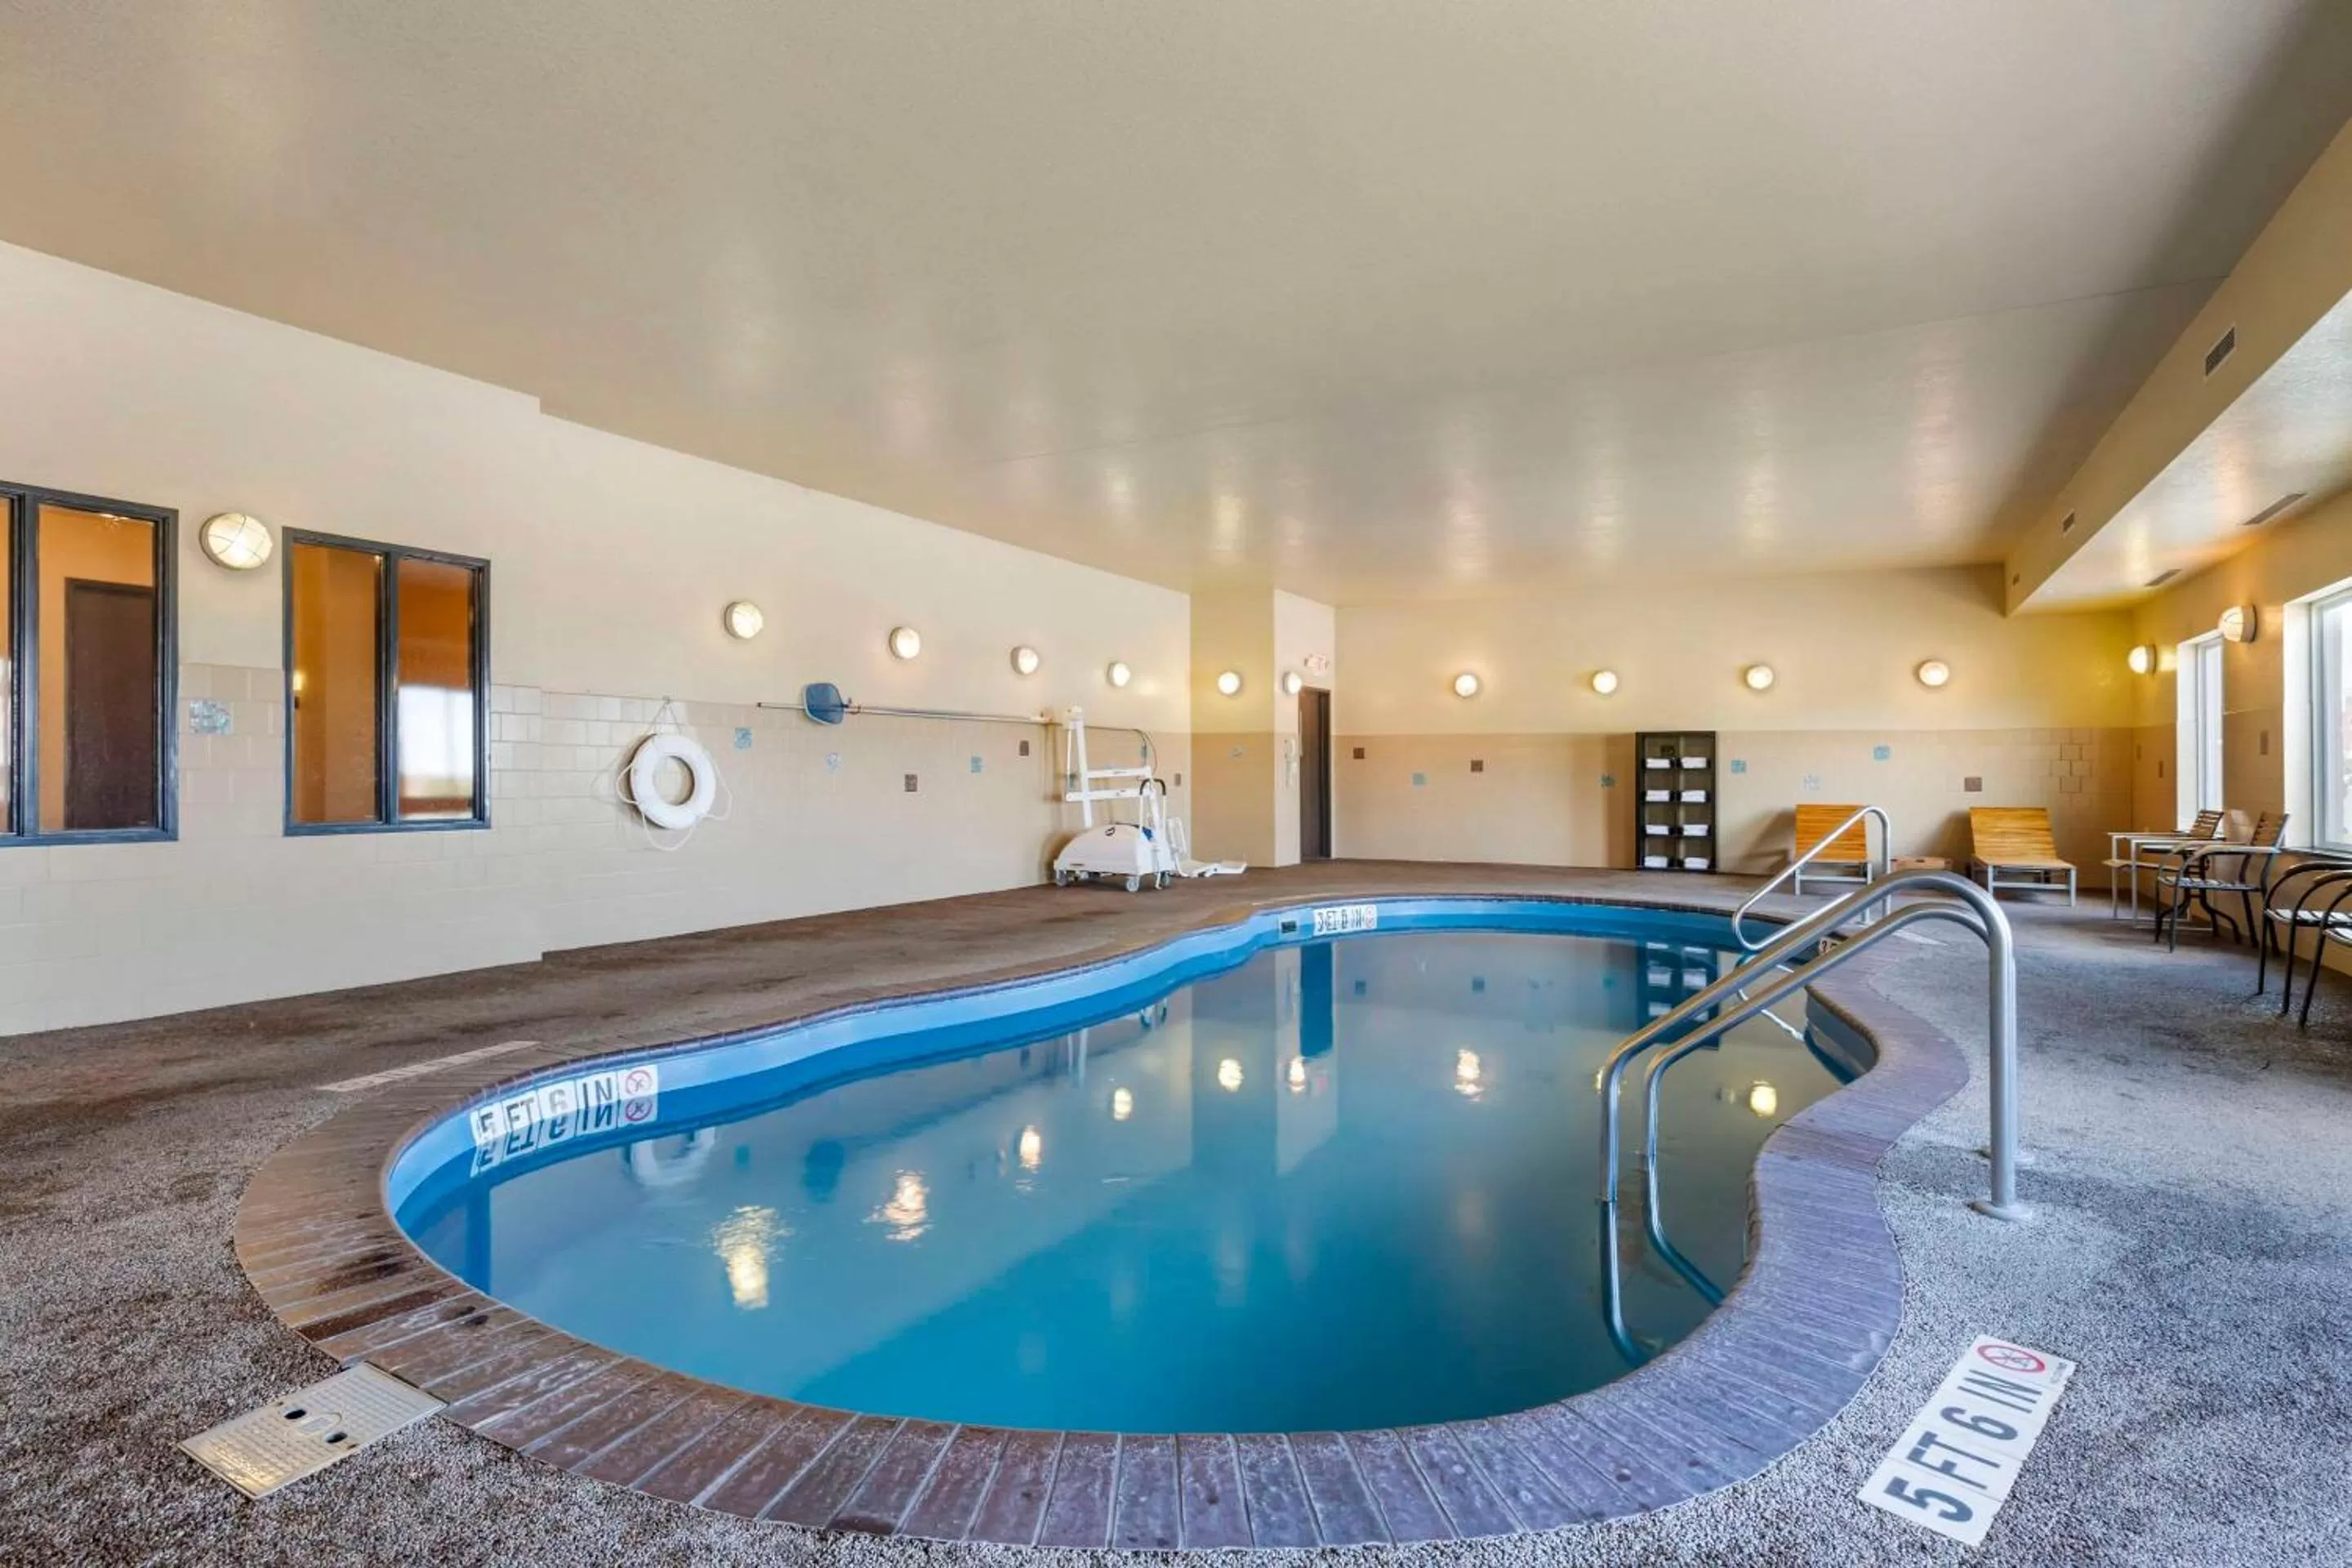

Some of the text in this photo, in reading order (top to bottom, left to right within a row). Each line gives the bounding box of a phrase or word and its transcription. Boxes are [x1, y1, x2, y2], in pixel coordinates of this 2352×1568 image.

[581, 1076, 613, 1108] IN
[1883, 1368, 2042, 1523] 5 FT 6 IN
